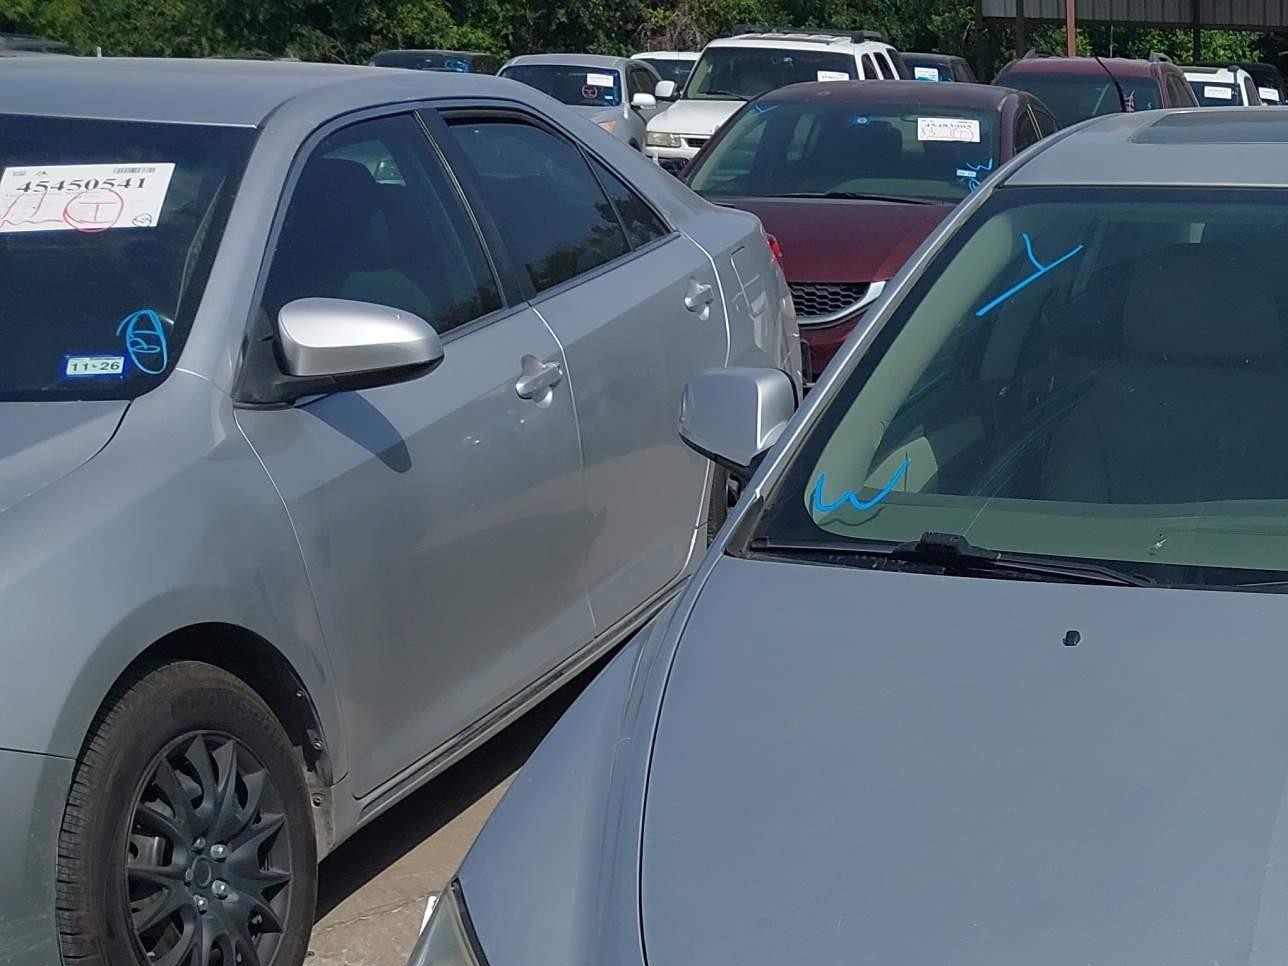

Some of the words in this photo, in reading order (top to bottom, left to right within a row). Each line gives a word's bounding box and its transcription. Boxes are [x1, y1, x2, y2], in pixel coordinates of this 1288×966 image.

[16, 178, 147, 193] 45450541
[976, 233, 1084, 317] Y
[811, 457, 911, 513] W
